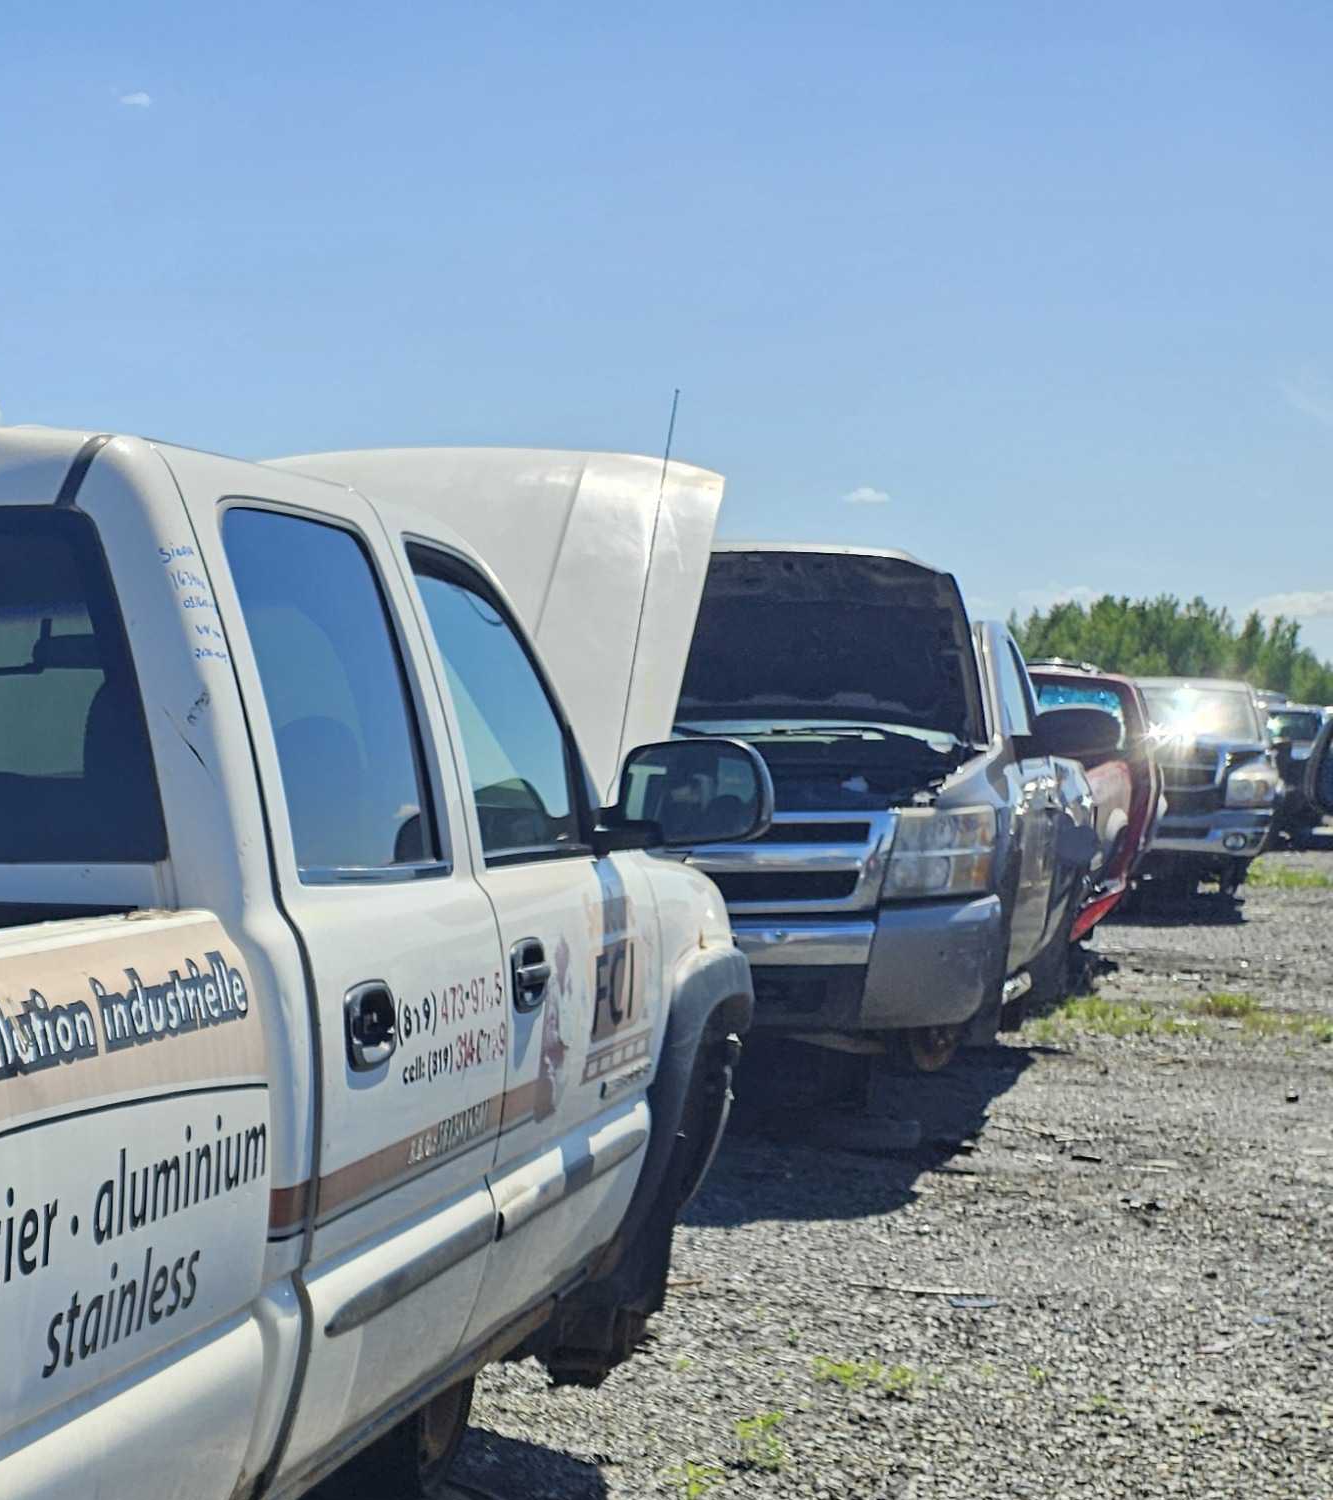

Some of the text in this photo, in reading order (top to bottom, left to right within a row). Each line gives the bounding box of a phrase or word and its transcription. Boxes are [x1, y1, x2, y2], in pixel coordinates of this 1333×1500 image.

[88, 951, 248, 1053] industrielle
[397, 972, 503, 1047] (819) 473-975
[403, 1055, 425, 1085] cell:
[93, 1114, 267, 1246] aluminium
[41, 1247, 200, 1379] stainless
